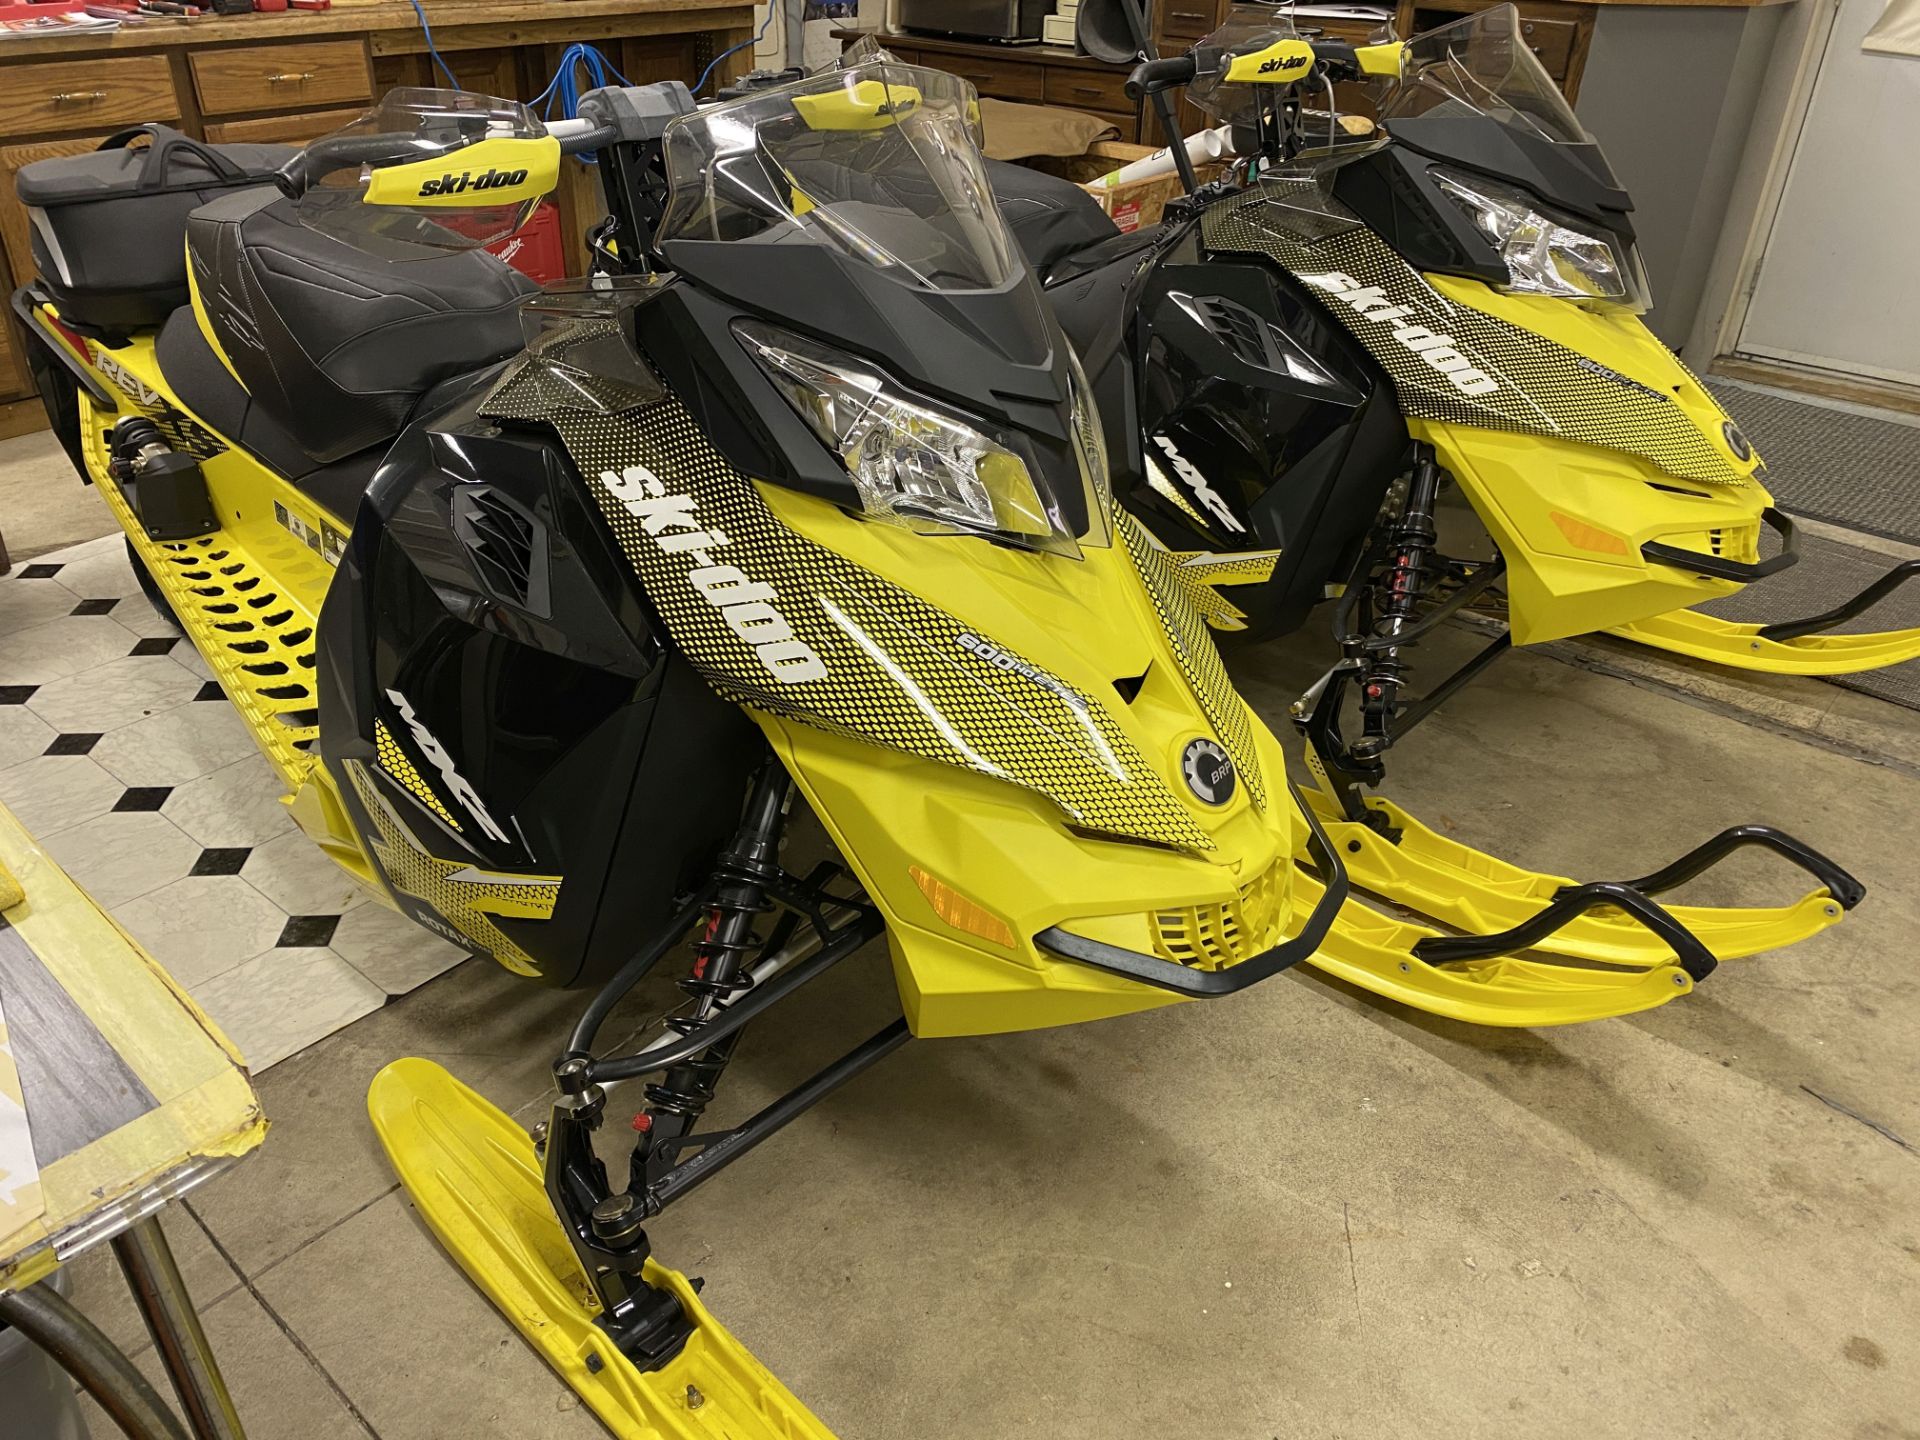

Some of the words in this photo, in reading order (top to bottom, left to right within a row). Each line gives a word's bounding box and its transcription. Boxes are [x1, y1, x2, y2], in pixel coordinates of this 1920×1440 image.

[1257, 55, 1307, 74] ski-doo
[418, 168, 528, 197] ski-doo
[1320, 270, 1500, 396] ski-doo
[96, 350, 159, 406] REV
[600, 465, 829, 685] ski-doo
[956, 632, 1017, 671] 600
[1013, 662, 1036, 679] HO
[1210, 760, 1231, 785] BRP
[415, 909, 473, 950] ROTAX
